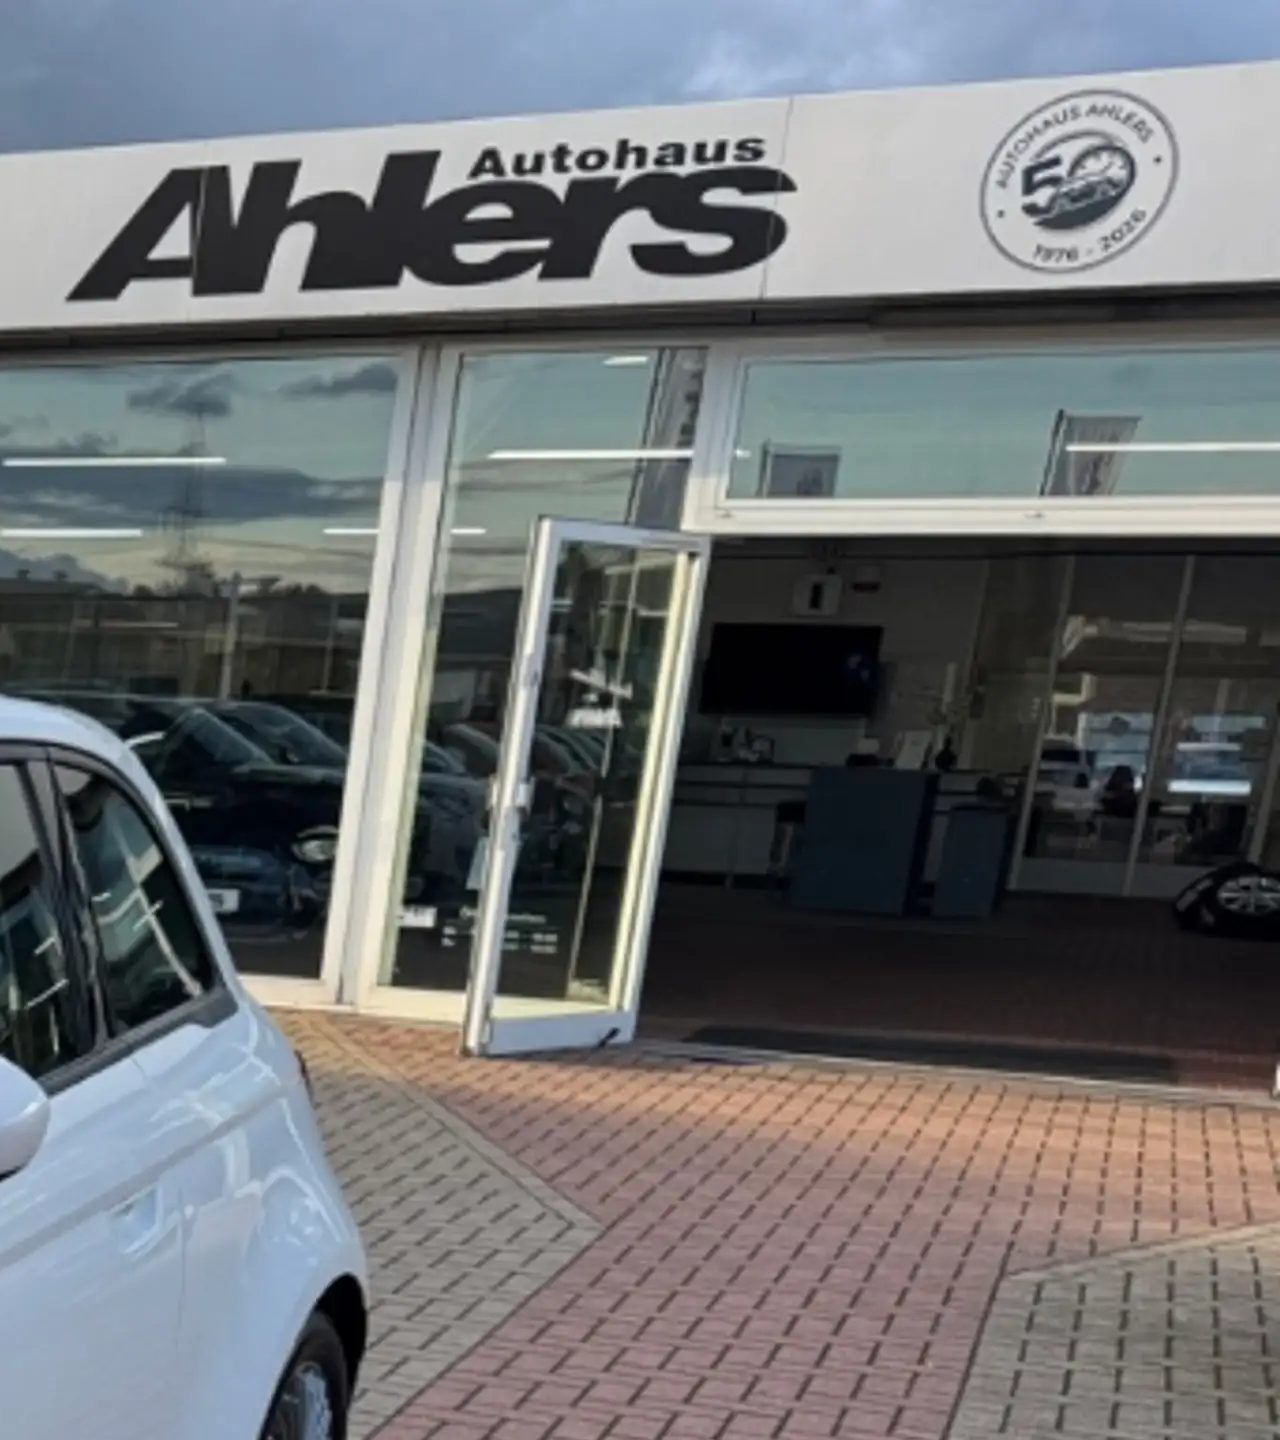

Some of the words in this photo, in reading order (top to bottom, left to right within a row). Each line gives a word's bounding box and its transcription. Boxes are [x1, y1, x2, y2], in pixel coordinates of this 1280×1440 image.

[469, 136, 767, 179] Autohaus
[995, 104, 1081, 190] AUTOHAUS
[1085, 102, 1157, 145] AHLERS
[65, 149, 798, 302] Ahlers
[1032, 242, 1080, 263] 1976
